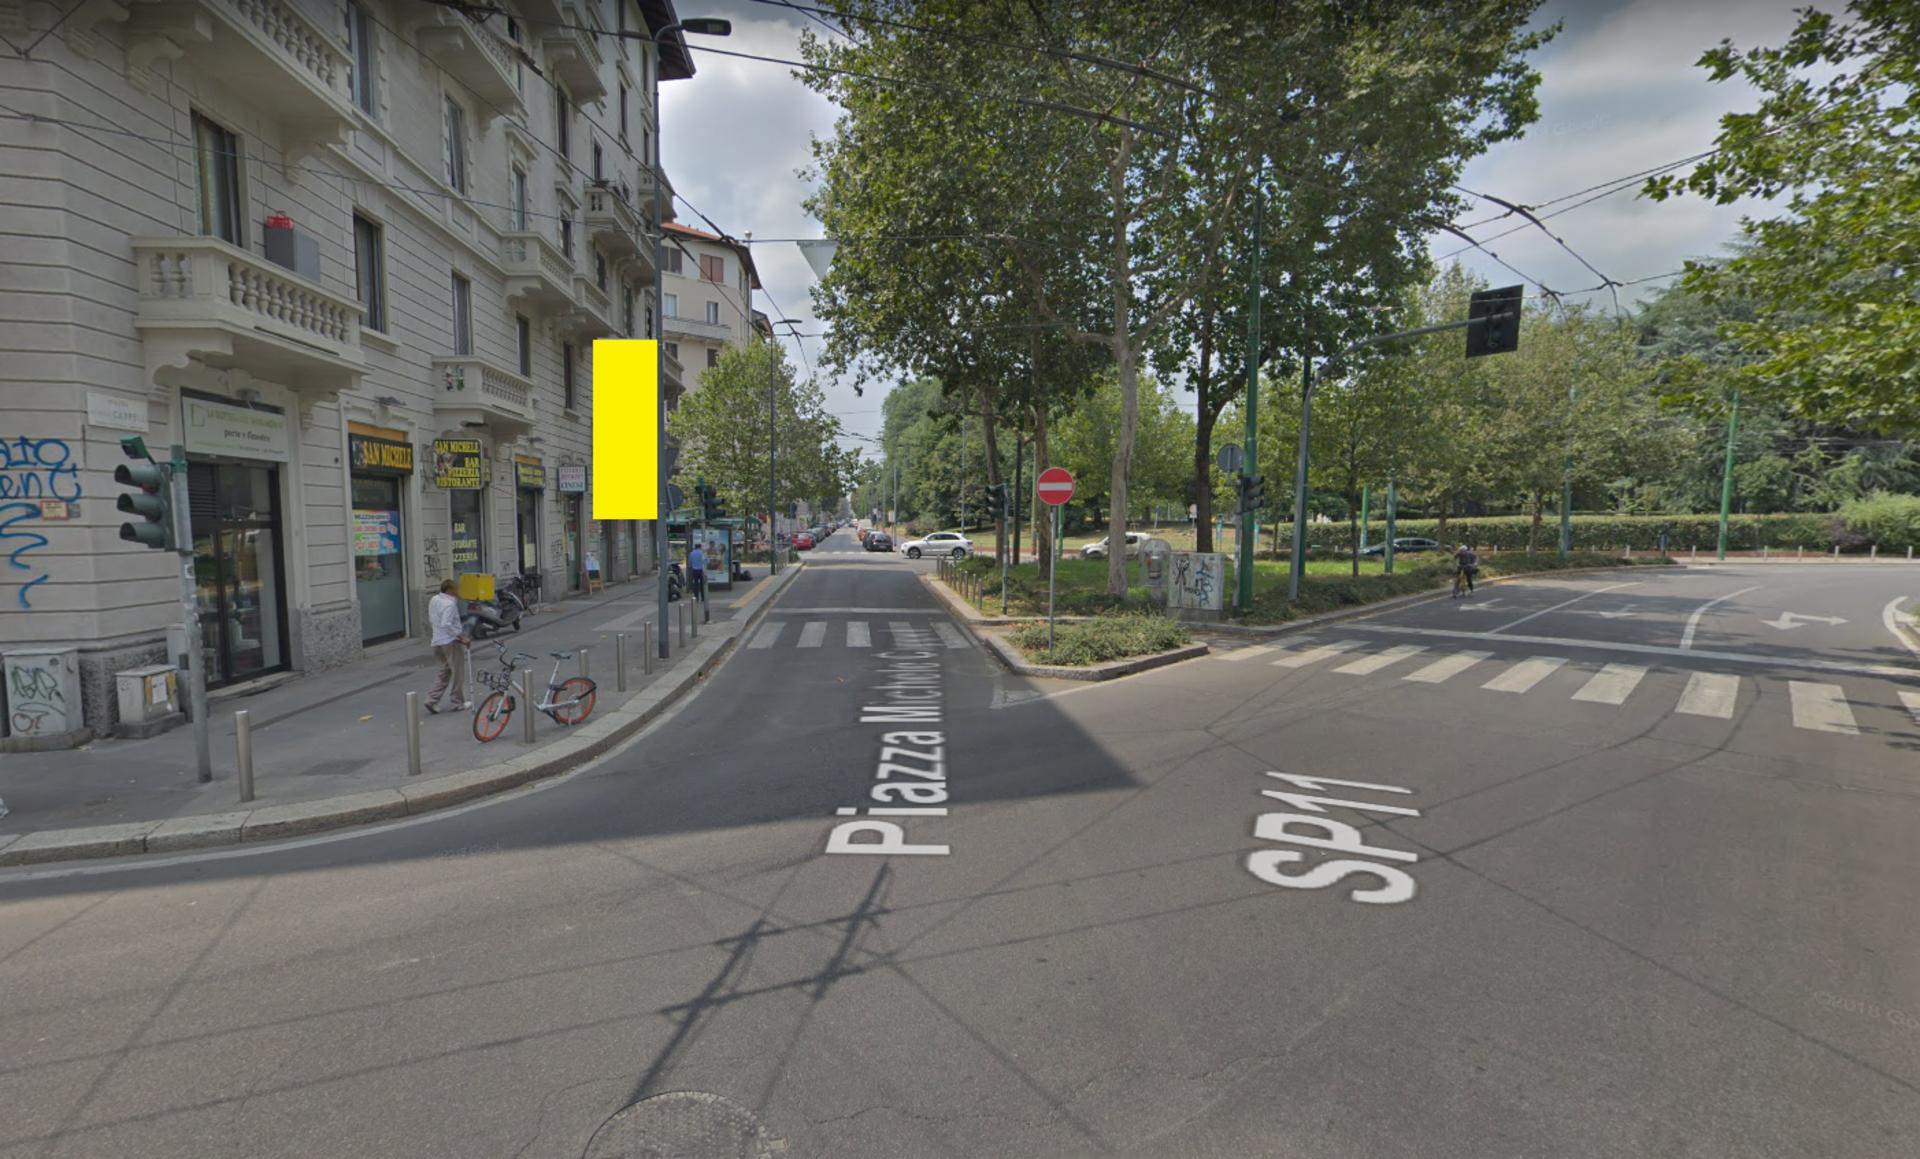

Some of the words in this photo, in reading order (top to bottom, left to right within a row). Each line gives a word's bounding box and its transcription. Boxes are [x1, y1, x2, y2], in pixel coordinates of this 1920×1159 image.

[434, 440, 449, 454] SAN
[450, 441, 480, 454] MICHELE
[363, 440, 380, 465] SAN
[380, 443, 412, 469] MICHELE
[464, 457, 480, 468] BAR
[448, 467, 480, 477] PIZZERIA
[436, 477, 480, 488] RISTORANTE
[454, 523, 465, 533] BAR
